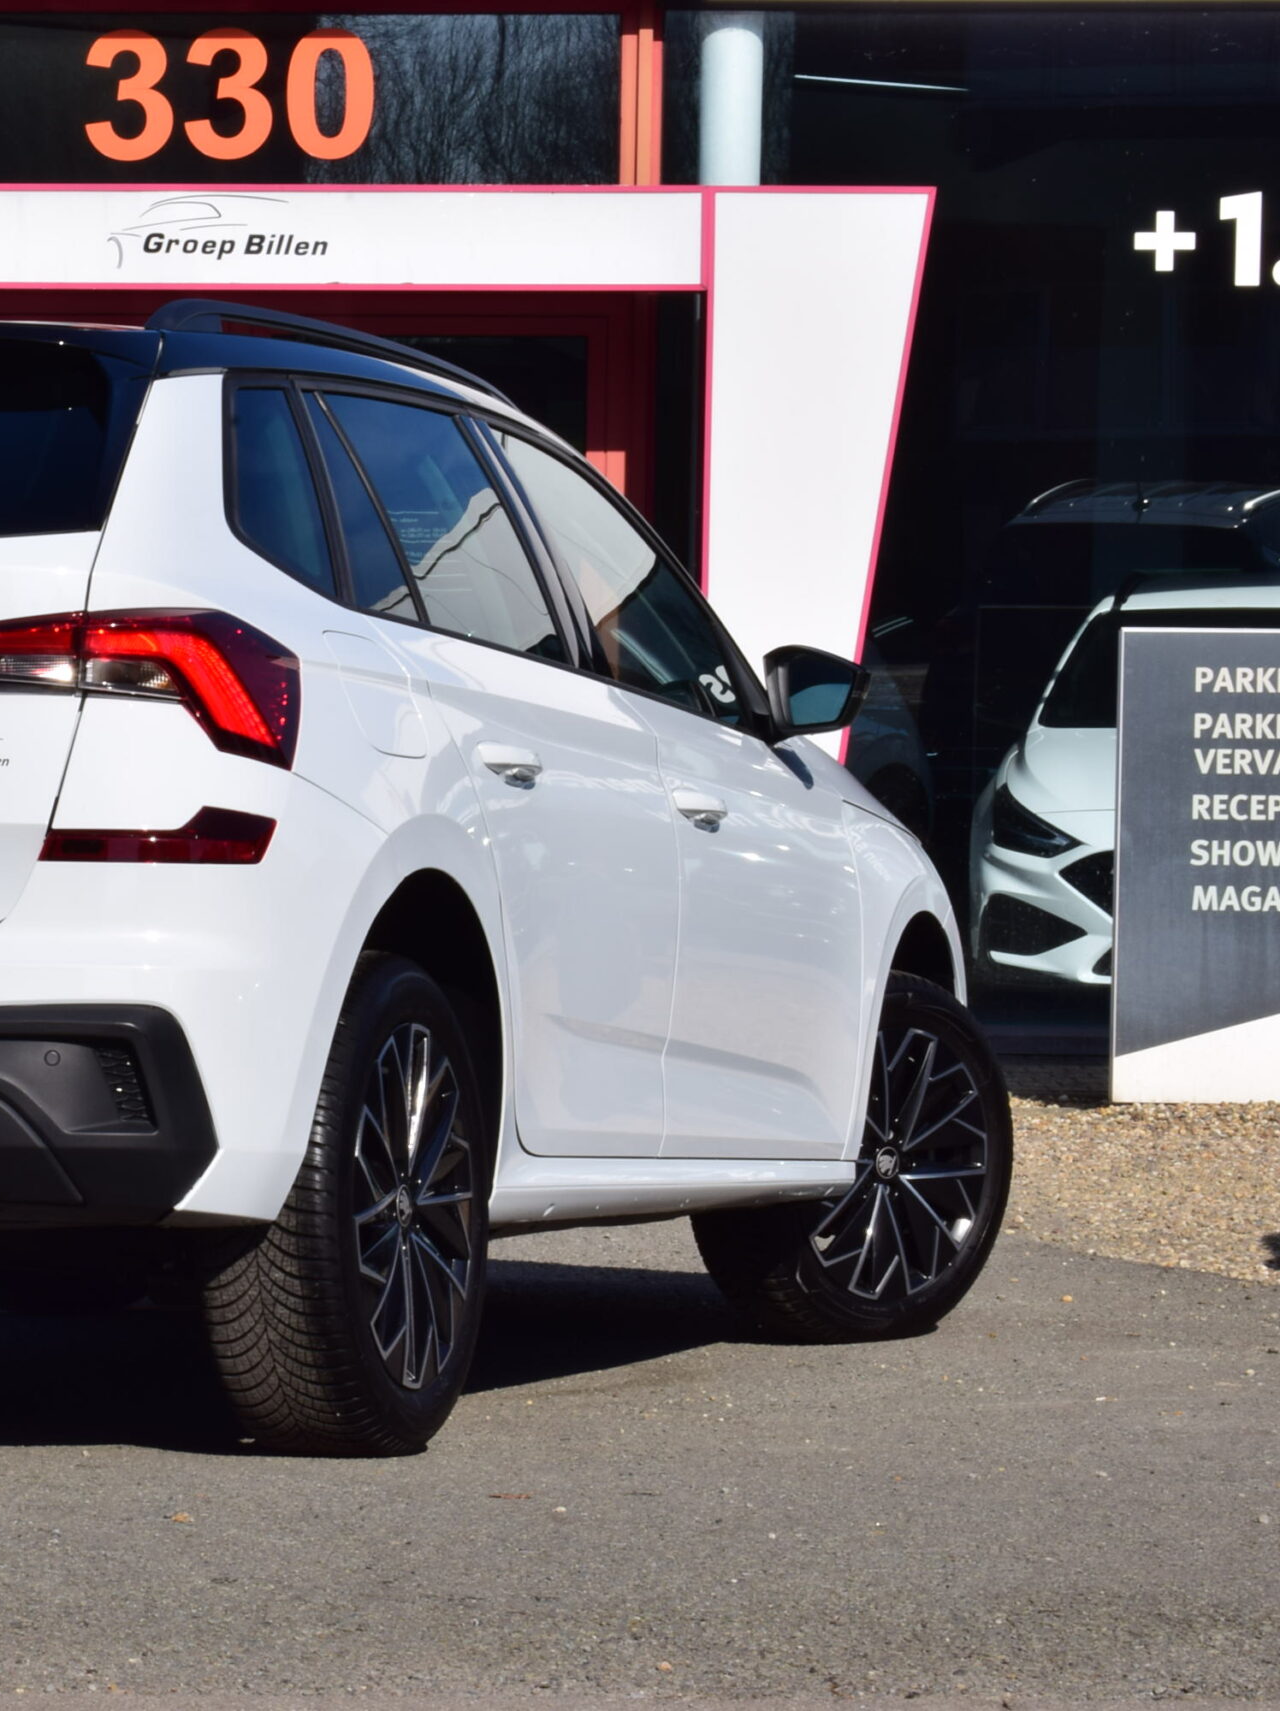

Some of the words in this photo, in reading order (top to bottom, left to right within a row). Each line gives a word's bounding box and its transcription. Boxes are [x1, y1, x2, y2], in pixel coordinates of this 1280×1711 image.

[84, 27, 375, 162] 330
[142, 233, 236, 260] Groep
[243, 234, 329, 257] Billen
[1191, 794, 1280, 820] RECEP
[1190, 839, 1280, 866] SHOW
[1191, 885, 1280, 912] MAGA
